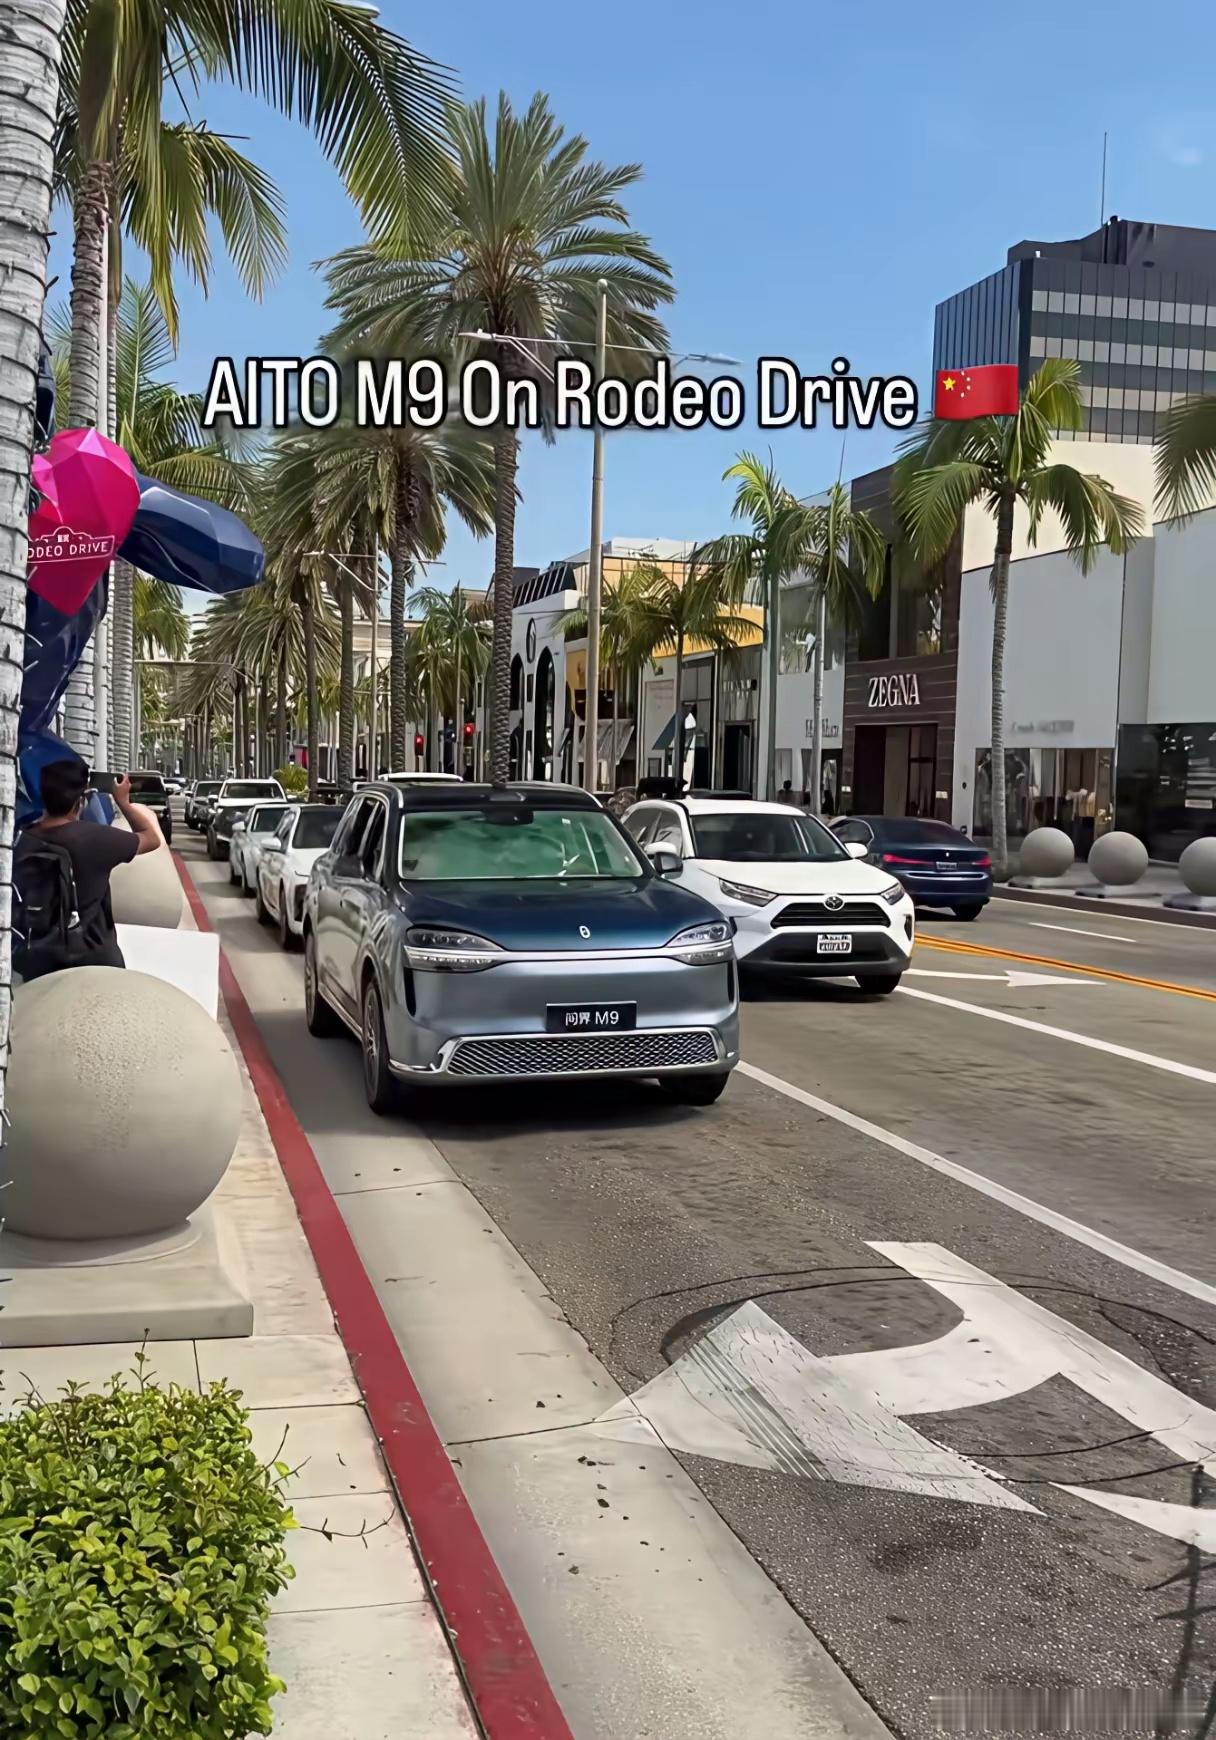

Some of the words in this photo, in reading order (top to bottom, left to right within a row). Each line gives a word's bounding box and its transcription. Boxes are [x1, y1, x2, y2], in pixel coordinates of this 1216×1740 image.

[28, 545, 63, 558] ODEO
[69, 541, 108, 555] DRIVE
[868, 673, 921, 708] ZEGNA
[595, 1010, 619, 1025] M9
